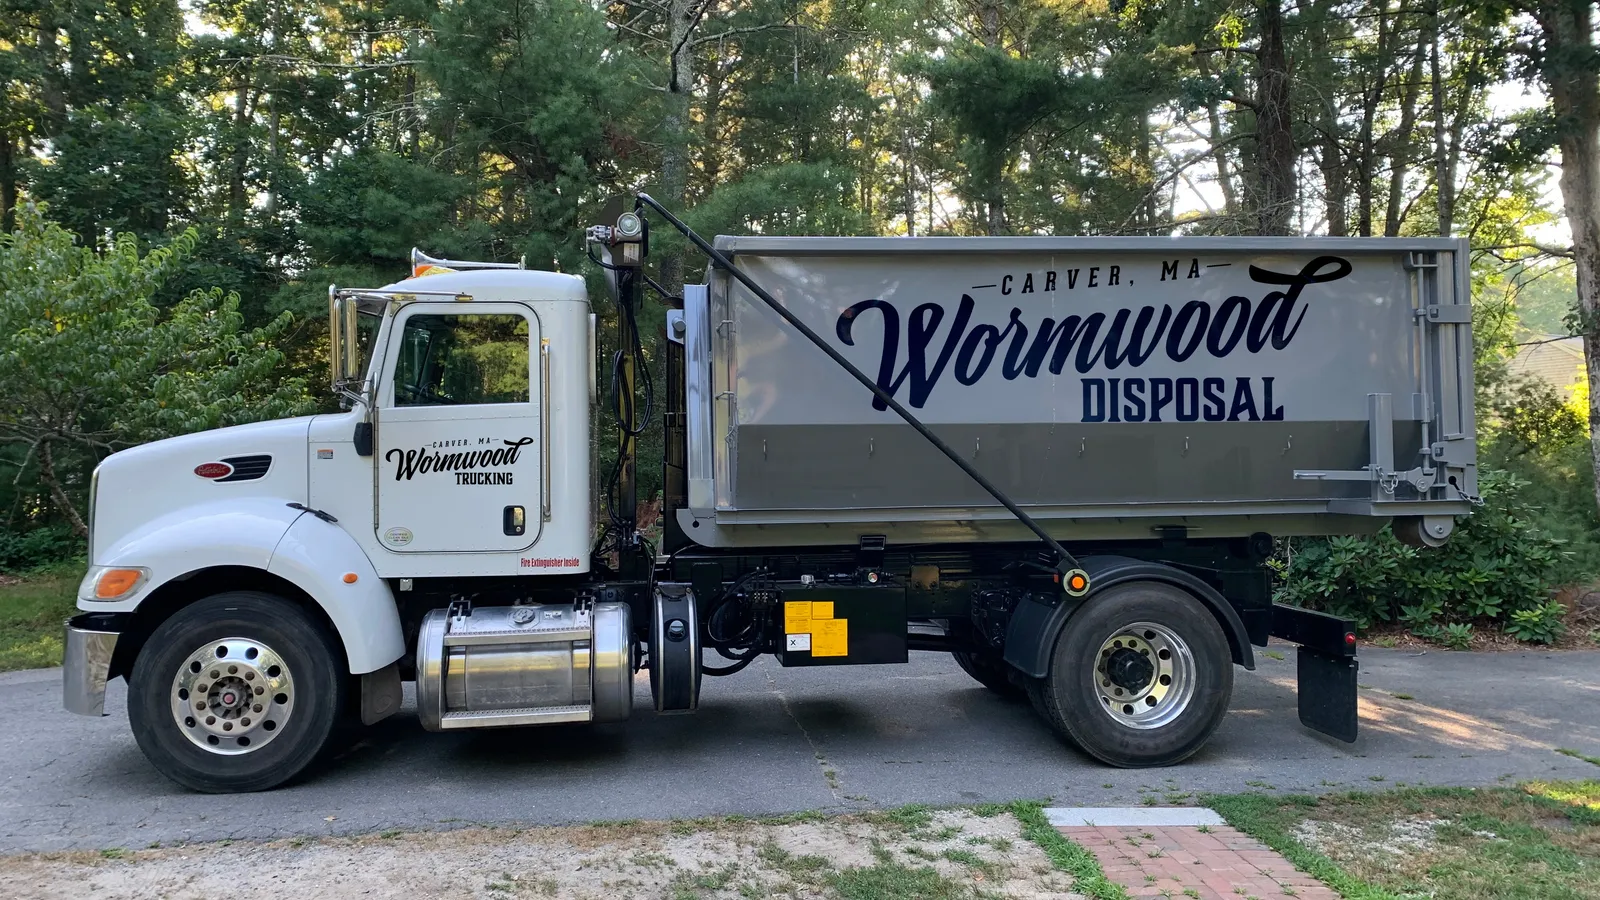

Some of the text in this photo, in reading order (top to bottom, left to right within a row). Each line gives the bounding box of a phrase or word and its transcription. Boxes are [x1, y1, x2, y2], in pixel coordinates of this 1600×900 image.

[1001, 257, 1201, 296] CARVER, MA
[836, 256, 1352, 411] Wormwood
[1081, 377, 1284, 423] DISPOSAL
[385, 436, 534, 482] Wormwood
[477, 437, 491, 445] MA
[454, 472, 513, 486] TRUCKING
[520, 557, 580, 568] Fire Extinguisher Inside
